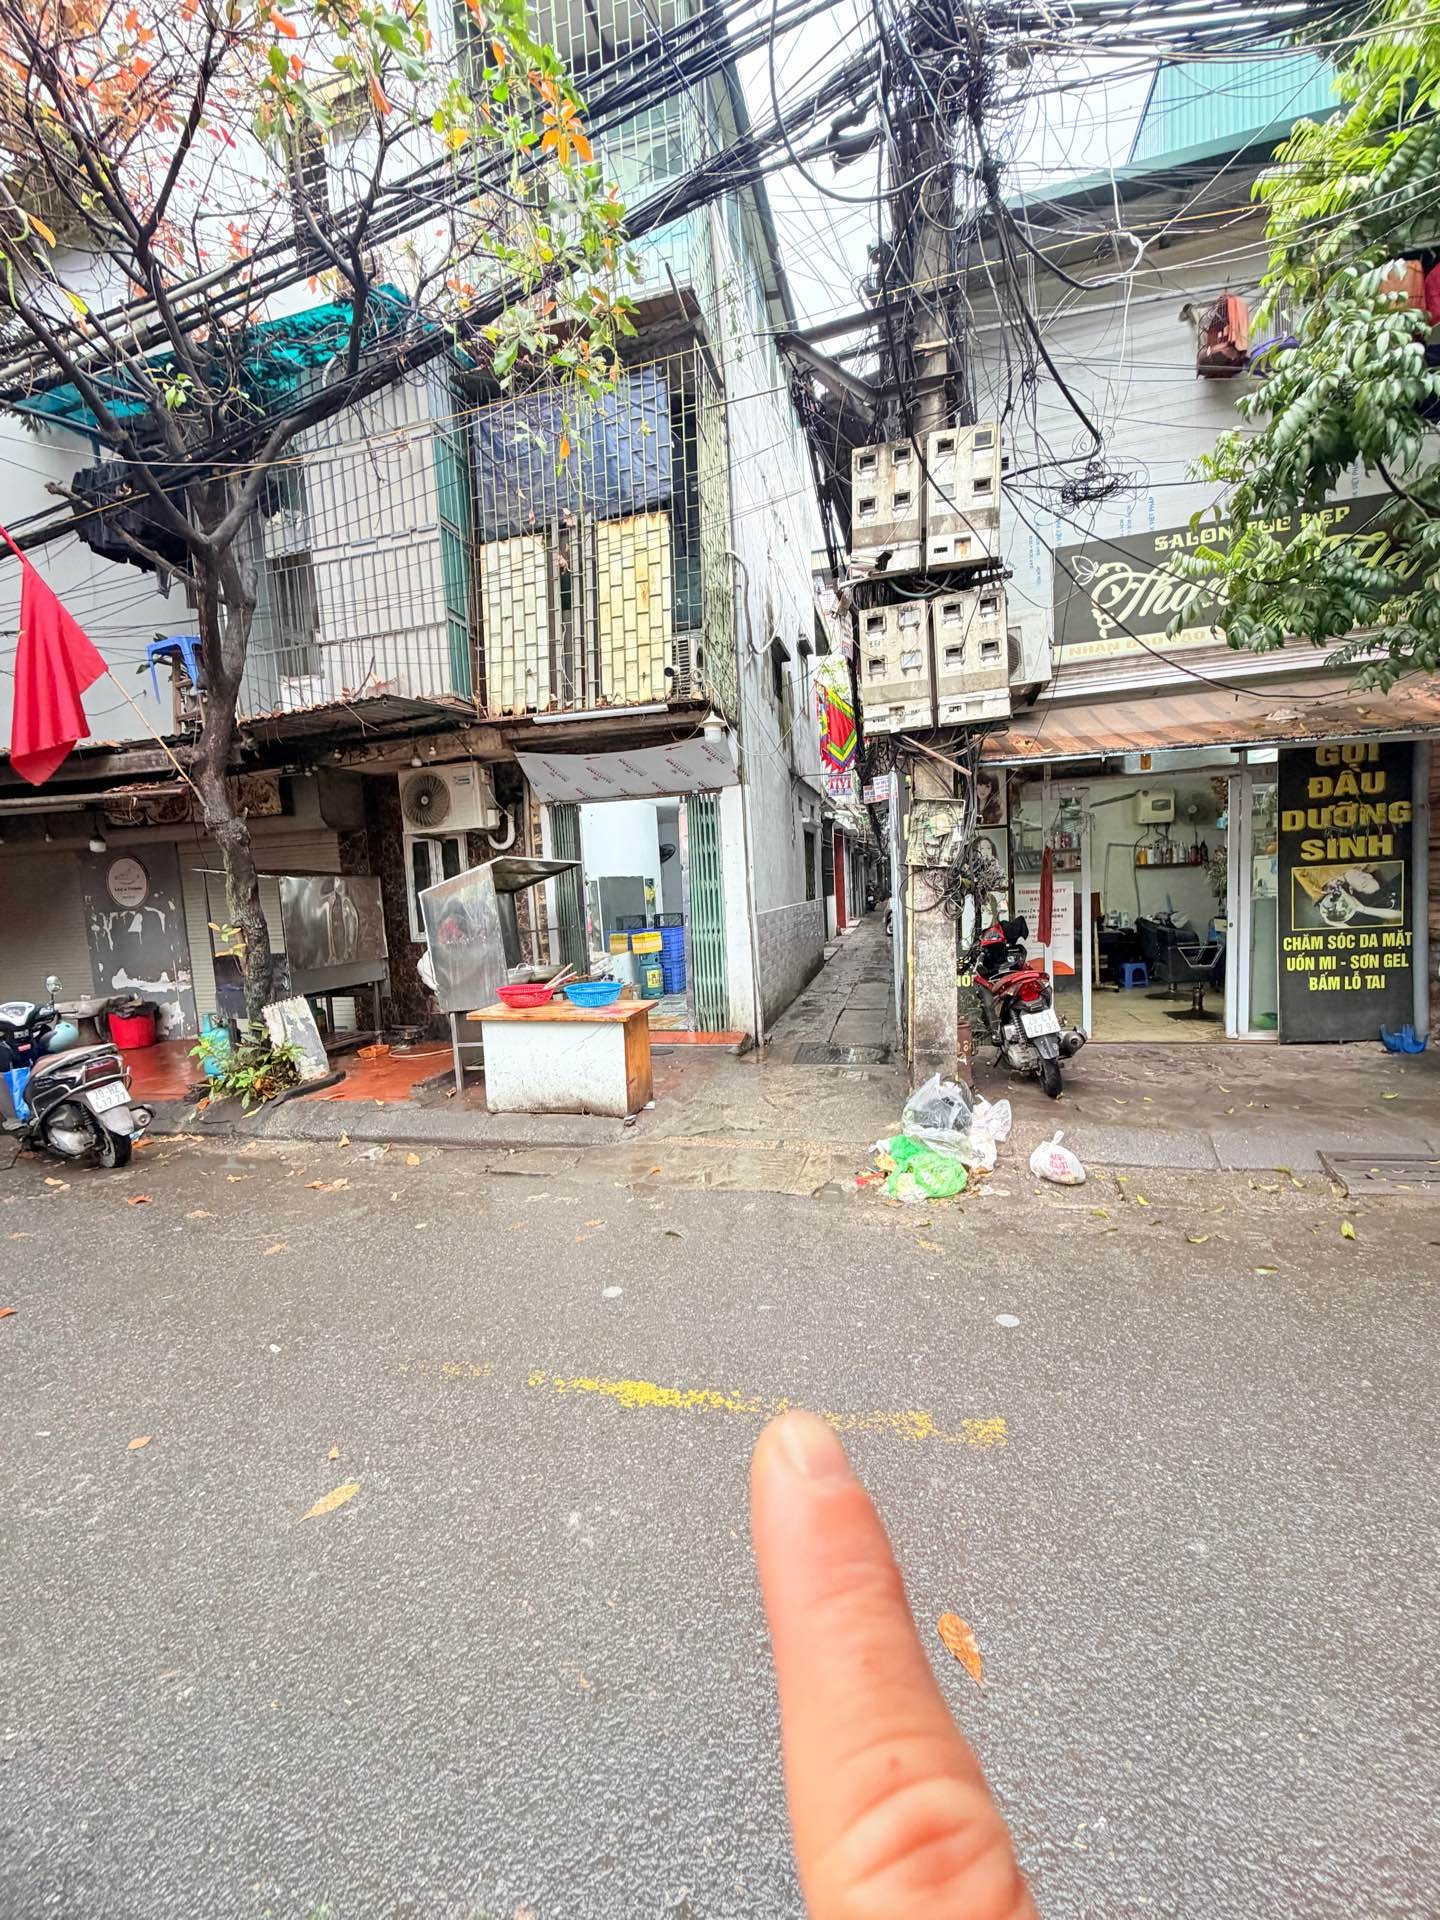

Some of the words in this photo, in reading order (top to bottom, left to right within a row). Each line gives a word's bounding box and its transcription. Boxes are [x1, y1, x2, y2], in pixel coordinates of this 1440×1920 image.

[1154, 525, 1234, 552] SALON
[1307, 768, 1387, 799] ĐẦU
[1281, 801, 1412, 832] DƯỠNG
[1300, 834, 1394, 861] SINH
[1283, 934, 1324, 951] CHĂM
[1327, 931, 1356, 950] SÓC
[1359, 933, 1378, 948] DA
[1382, 929, 1413, 950] MẶT
[1286, 952, 1315, 972] UỐN
[1319, 955, 1337, 971] MI
[1350, 953, 1379, 970] SƠN
[1383, 953, 1410, 969] GEL
[1309, 971, 1341, 991] BẤM
[1344, 970, 1362, 990] LỖ
[1365, 974, 1386, 990] TAI
